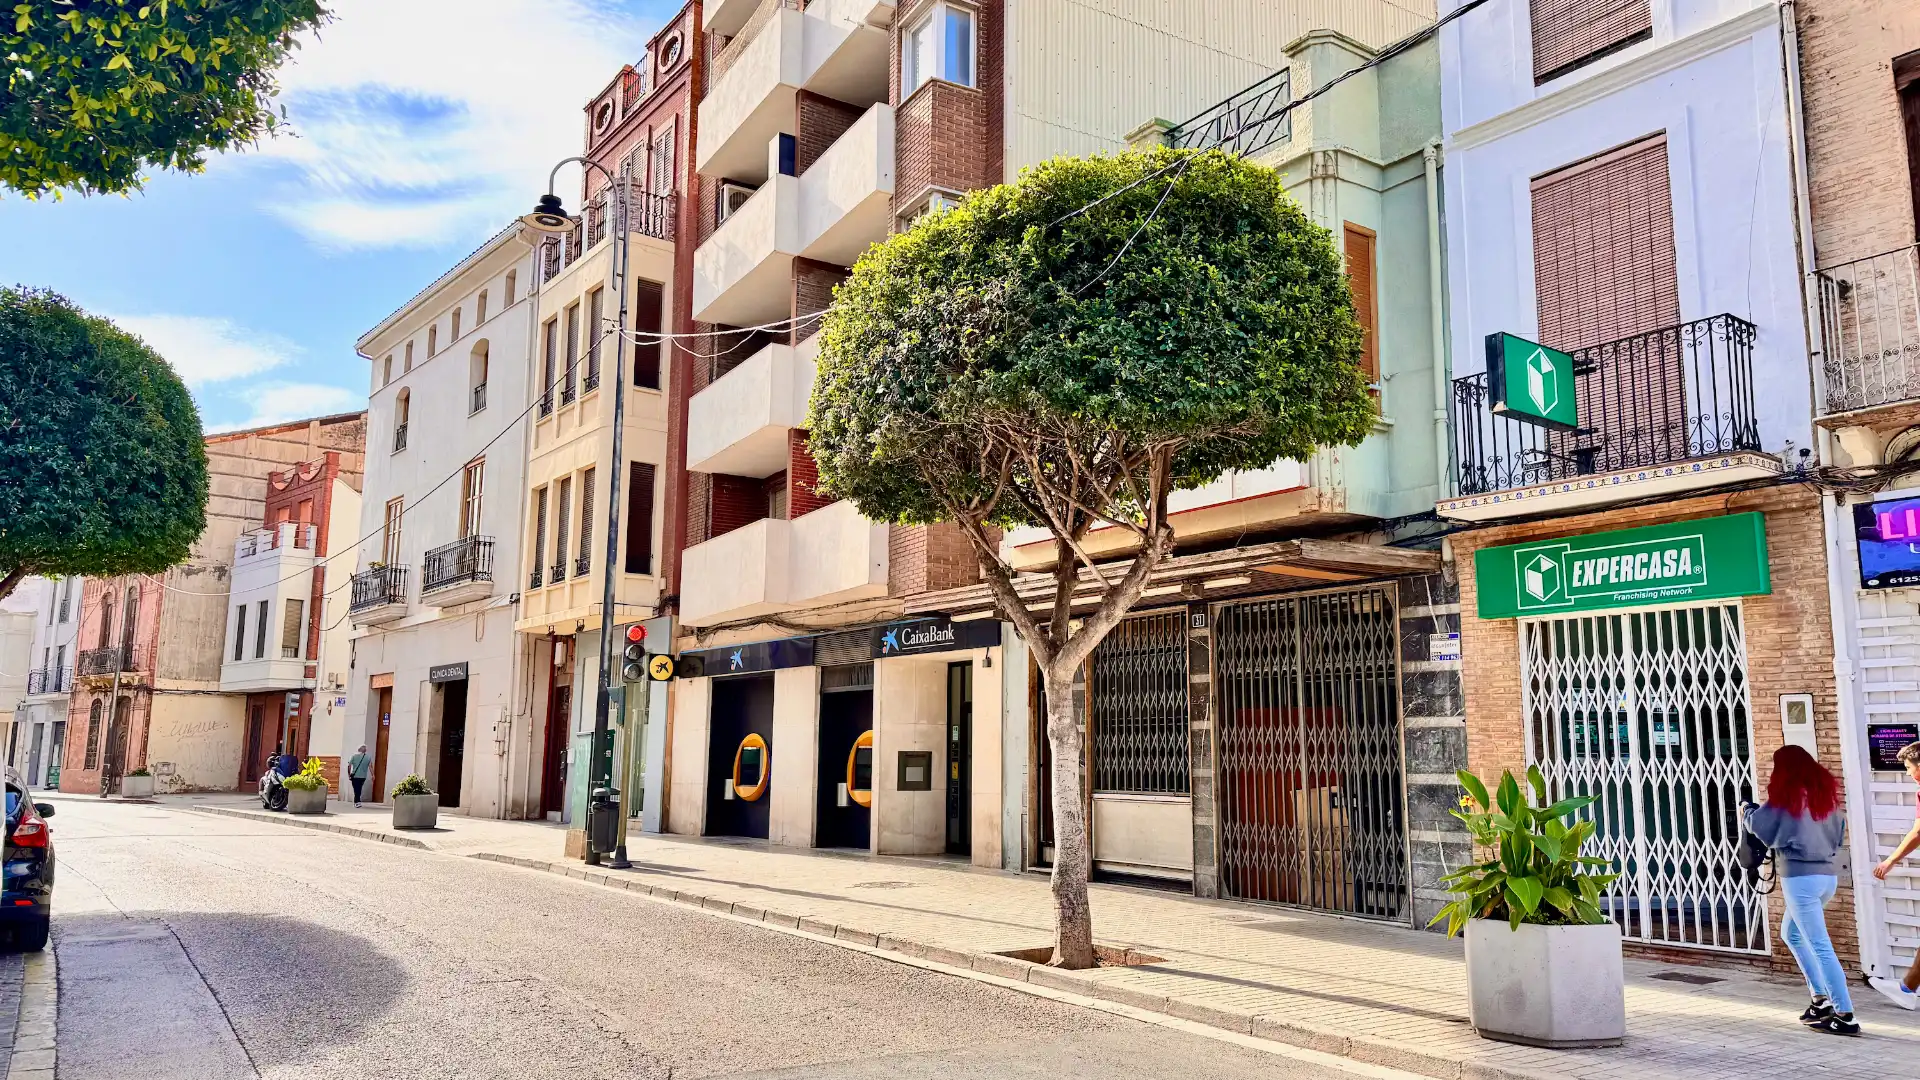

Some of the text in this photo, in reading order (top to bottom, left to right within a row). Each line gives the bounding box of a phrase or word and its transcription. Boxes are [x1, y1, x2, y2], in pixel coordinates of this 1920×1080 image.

[1572, 547, 1692, 588] EXPERCASA
[1889, 575, 1920, 584] 6125
[1613, 587, 1693, 601] Franchising Network
[901, 623, 955, 645] CaixaBank
